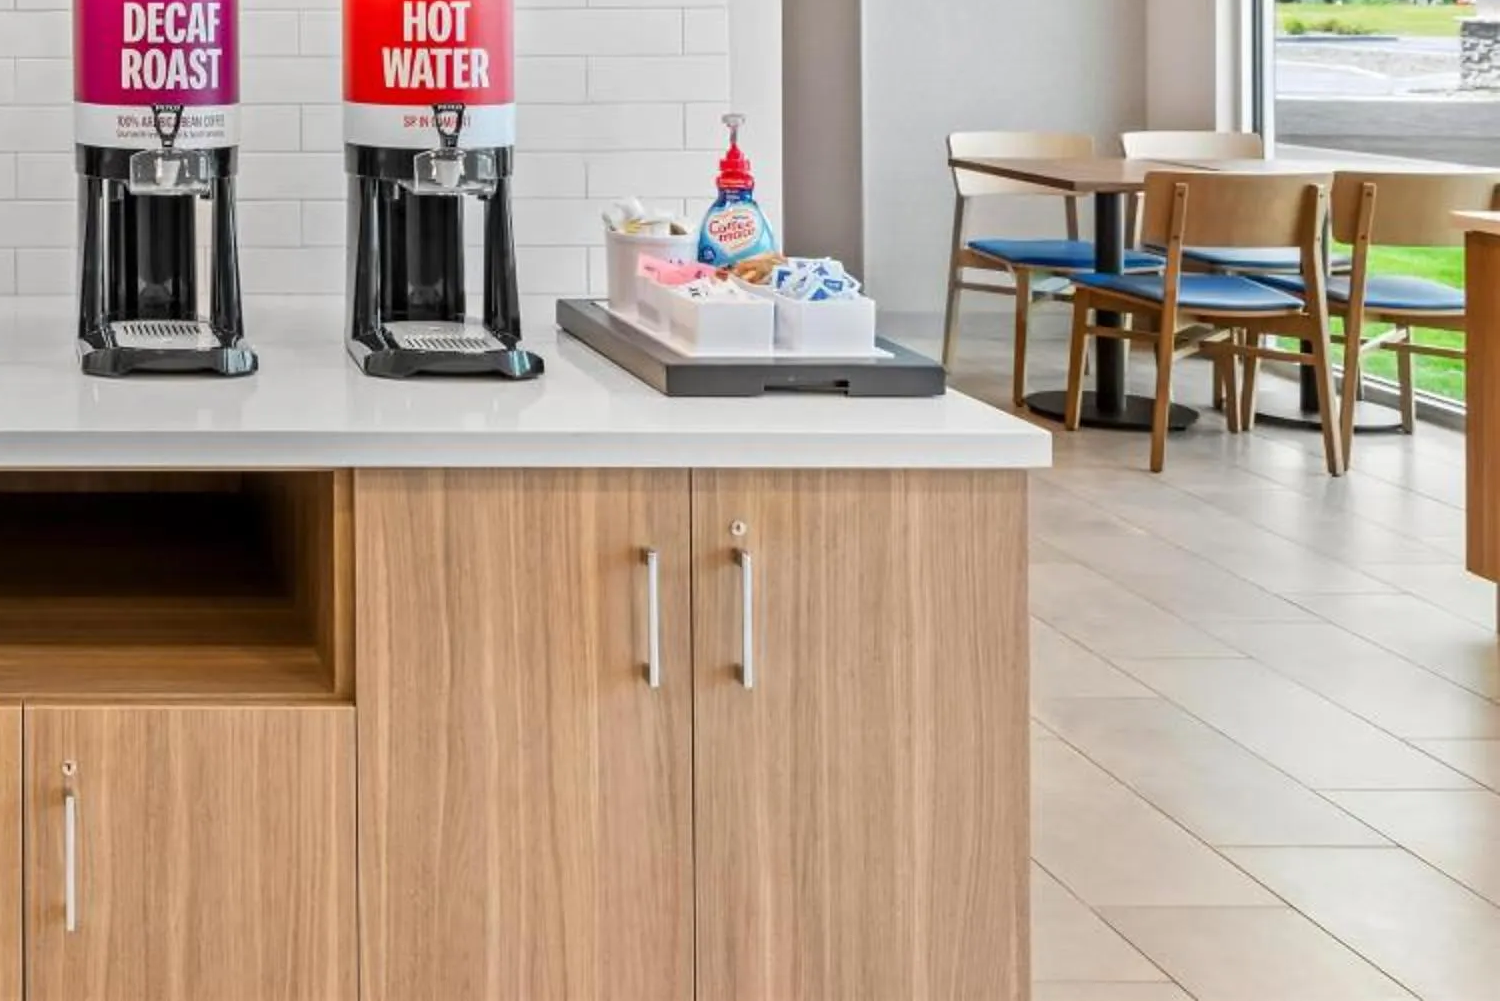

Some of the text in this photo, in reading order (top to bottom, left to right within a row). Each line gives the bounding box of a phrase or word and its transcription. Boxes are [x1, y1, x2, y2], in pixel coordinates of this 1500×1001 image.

[123, 2, 221, 43] DECAF
[403, 0, 472, 42] HOT
[121, 48, 223, 90] ROAST
[382, 47, 490, 89] WATER
